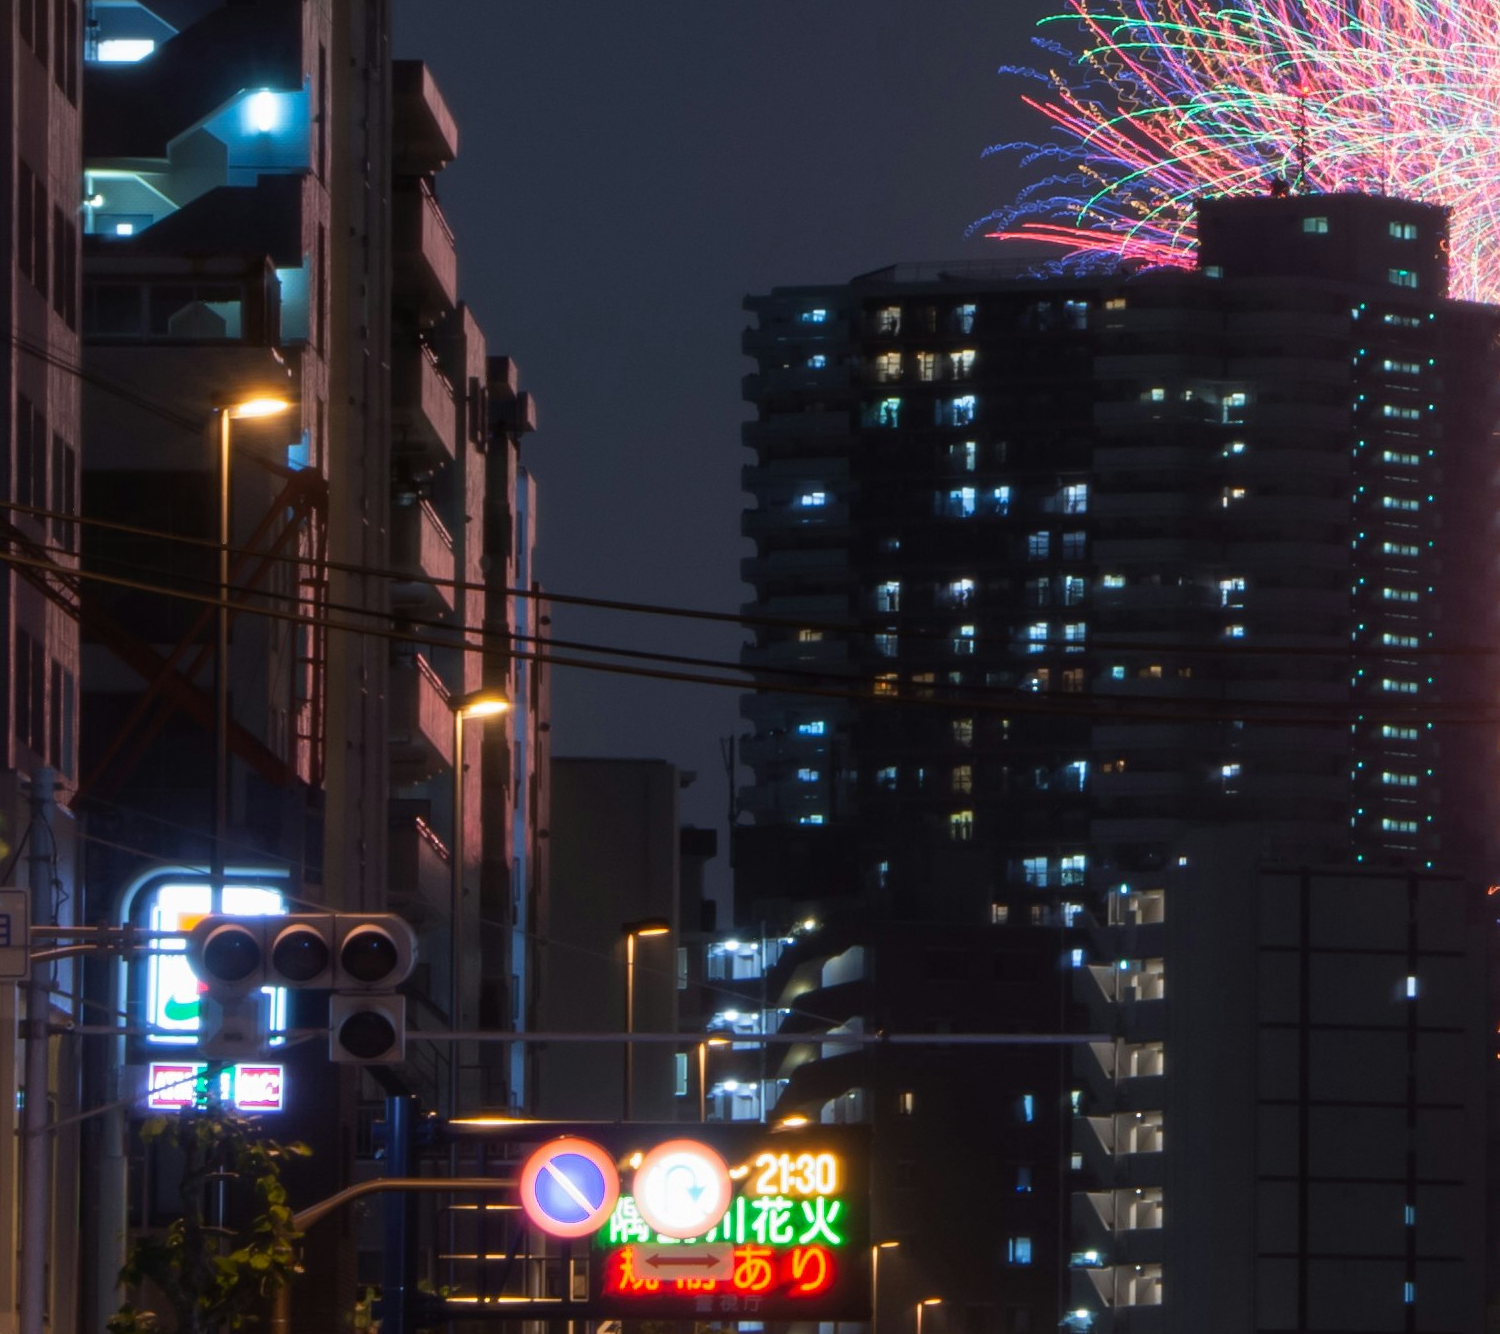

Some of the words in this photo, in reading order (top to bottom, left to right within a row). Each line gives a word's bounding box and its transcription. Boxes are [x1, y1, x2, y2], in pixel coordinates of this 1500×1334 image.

[755, 1153, 837, 1195] 21:30
[609, 1196, 842, 1244] 隅川花火
[618, 1246, 828, 1292] あり
